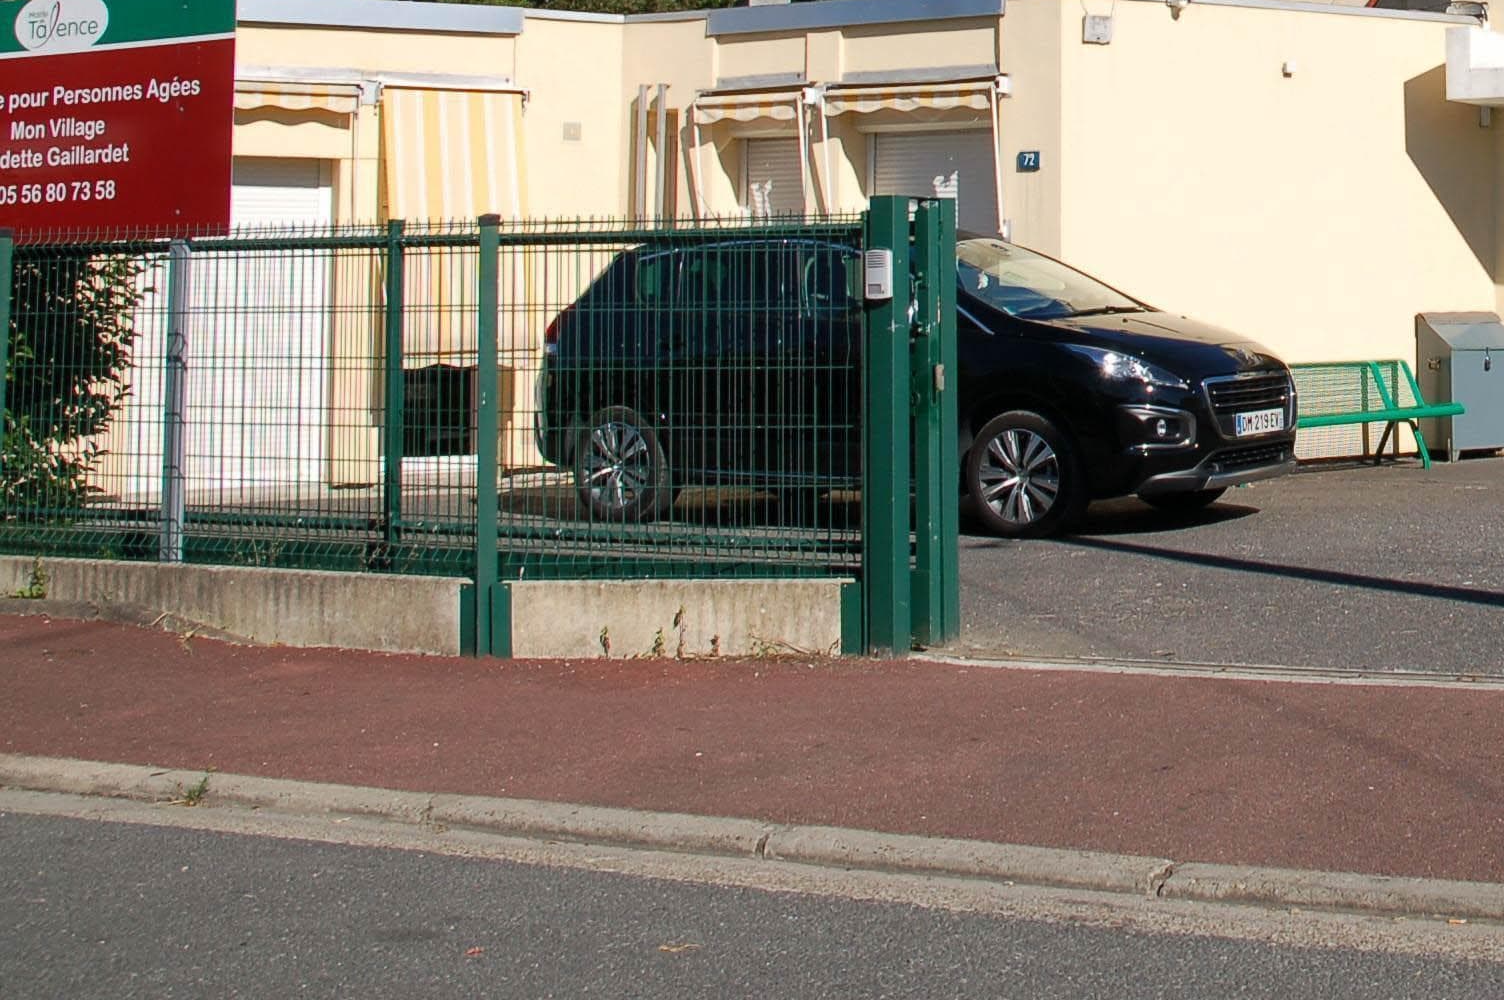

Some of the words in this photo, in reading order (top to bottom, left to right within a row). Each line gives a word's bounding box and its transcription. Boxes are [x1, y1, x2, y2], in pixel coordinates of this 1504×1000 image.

[28, 1, 98, 48] Talence
[9, 92, 49, 113] pour
[53, 84, 142, 106] Personnes
[146, 76, 201, 102] Agées
[10, 121, 45, 140] Mon
[49, 117, 105, 140] Village
[47, 143, 130, 166] Gaillardet
[1023, 153, 1035, 166] 72
[0, 185, 17, 205] 05
[21, 184, 42, 203] 56
[46, 182, 67, 202] 80
[71, 181, 91, 201] 73
[95, 179, 116, 200] 58
